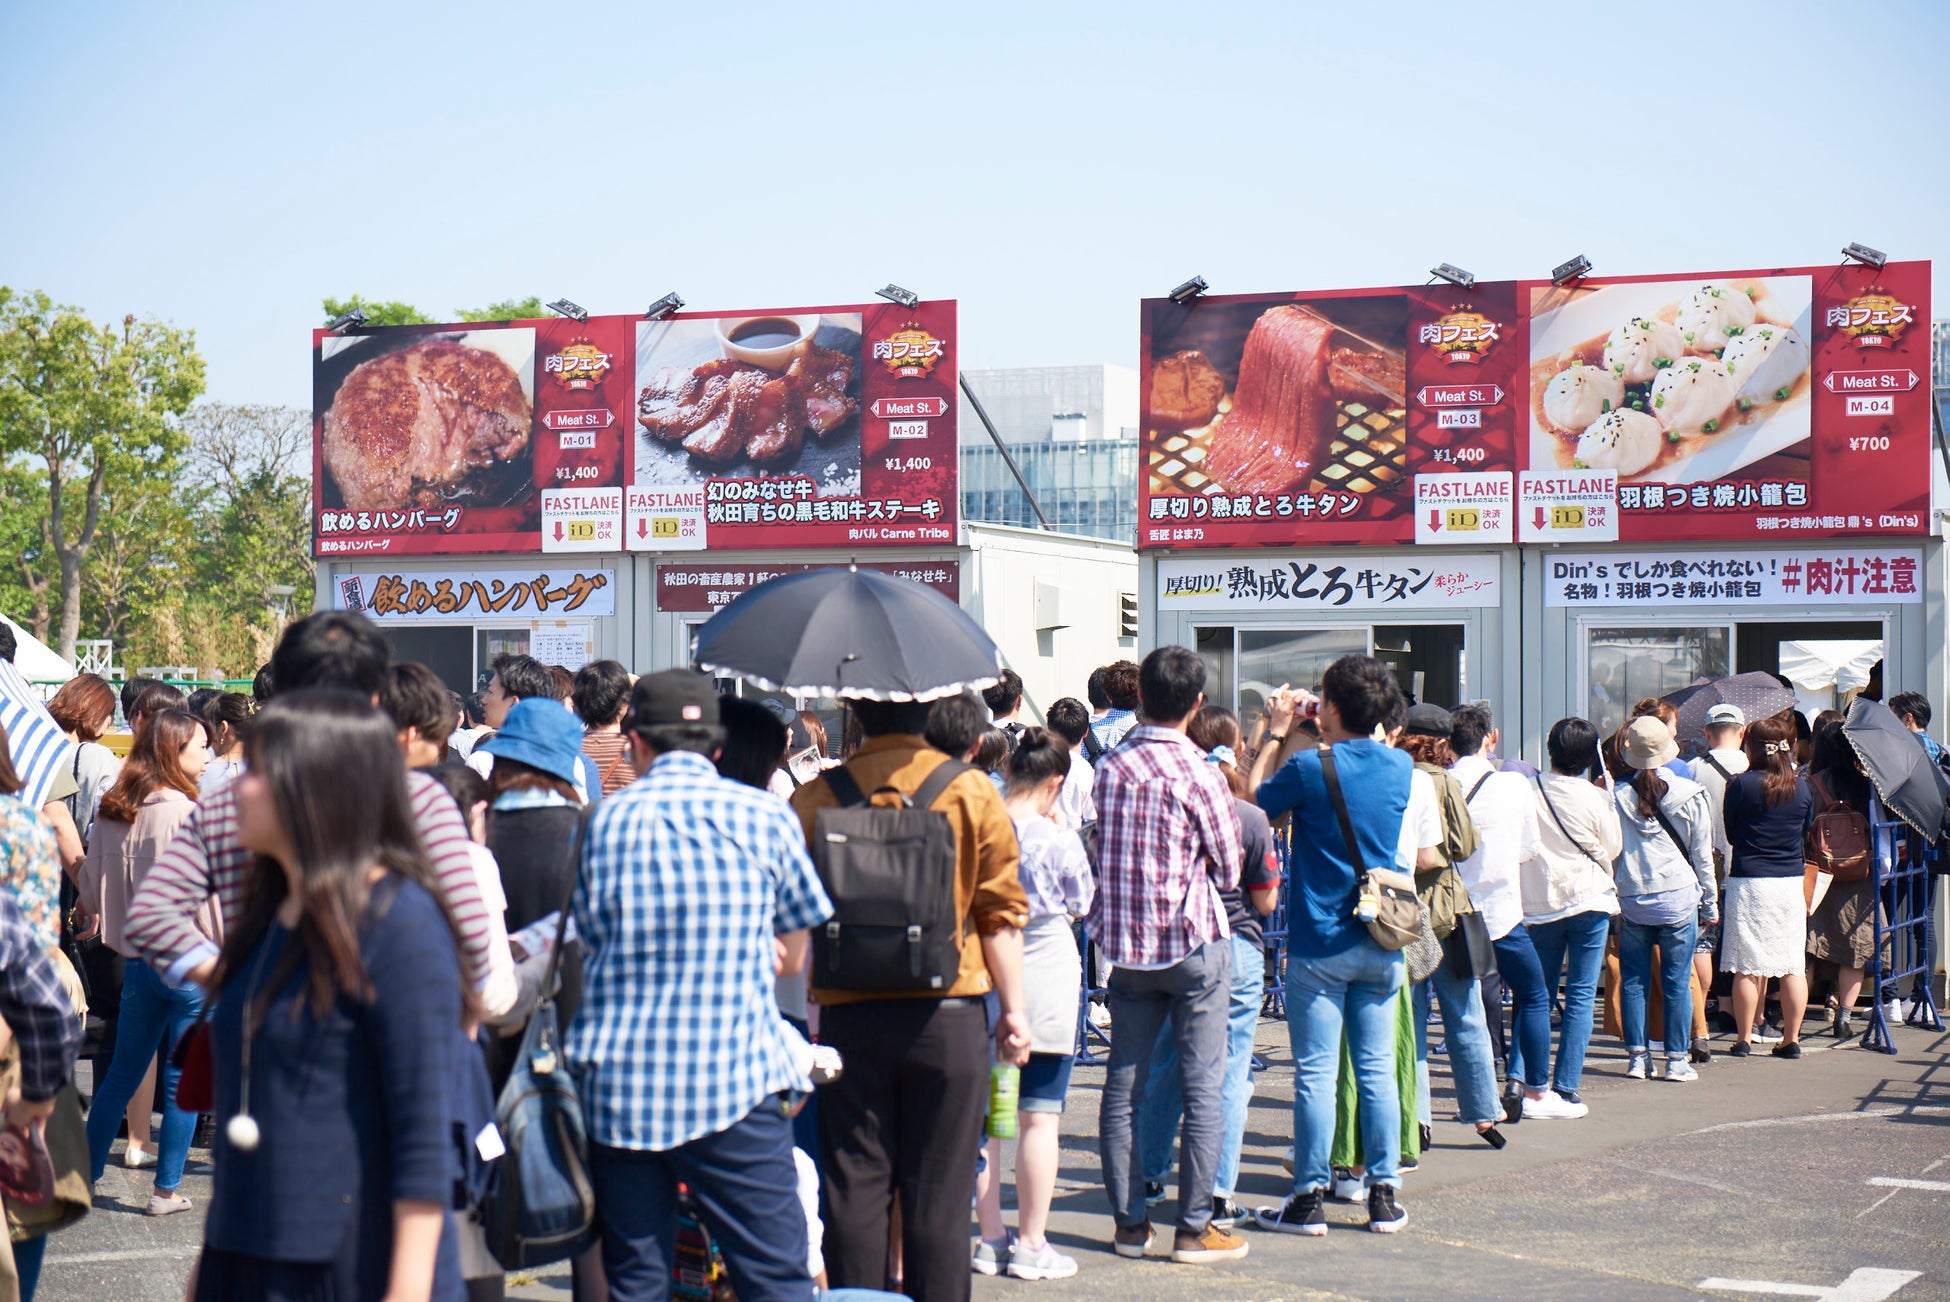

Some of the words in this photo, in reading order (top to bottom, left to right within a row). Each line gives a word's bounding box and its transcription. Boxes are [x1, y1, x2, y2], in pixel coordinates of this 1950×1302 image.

[1826, 305, 1913, 327] 肉フェス
[1420, 324, 1499, 343] 肉フェス
[1861, 337, 1882, 345] TOKYO
[873, 341, 943, 359] 肉フェス
[545, 354, 610, 372] 肉フェス
[1843, 376, 1877, 388] Meat
[1881, 375, 1898, 387] St.
[1435, 391, 1466, 402] Meat
[1469, 390, 1485, 401] St.
[887, 403, 914, 414] Meat
[917, 402, 932, 413] St.
[1851, 401, 1889, 412] M-04
[558, 415, 583, 425] Meat
[586, 414, 599, 424] St.
[1442, 414, 1477, 425] M-03
[893, 425, 924, 435] M-02
[563, 436, 592, 445] M-01
[1850, 436, 1890, 451] ¥700
[1434, 448, 1485, 464] ¥1,400
[885, 458, 931, 472] ¥1,400
[556, 466, 598, 481] ¥1,400
[707, 480, 813, 501] 幻のみなせ牛
[1419, 482, 1509, 497] FASTLANE
[1523, 478, 1614, 494] FASTLANE
[630, 493, 703, 507] FASTLANE
[1620, 483, 1808, 508] 羽根つき焼小籠包
[545, 496, 619, 510] FASTLANE
[1149, 494, 1359, 519] 厚切り熟成とろ牛タン
[708, 499, 941, 523] 秋田育ちの黒毛和牛ステーキ
[1482, 509, 1501, 519] 決済
[1555, 510, 1583, 524] iD
[1587, 506, 1606, 516] 決済
[321, 508, 461, 532] 飲めるハンバーグ
[597, 521, 612, 530] 決済
[681, 518, 696, 527] 決済
[1450, 512, 1478, 526] iD
[1483, 520, 1500, 530] OK
[1588, 517, 1605, 527] OK
[1756, 516, 1845, 530] 羽根つき焼小籠包
[571, 524, 593, 537] iD
[655, 521, 677, 534] iD
[681, 528, 696, 537] OK
[849, 528, 877, 539] 肉バル
[881, 528, 915, 538] Carne
[918, 527, 949, 538] Tribe
[597, 531, 612, 540] OK
[321, 539, 390, 552] 飲めるハンバーグ
[1435, 572, 1469, 587] 柔らか
[1782, 556, 1917, 595] #肉汁注意
[1227, 561, 1435, 606] 熟成とろ牛タン
[1447, 581, 1493, 597] ジューシー
[368, 574, 607, 616] 飲めるハンバーグ
